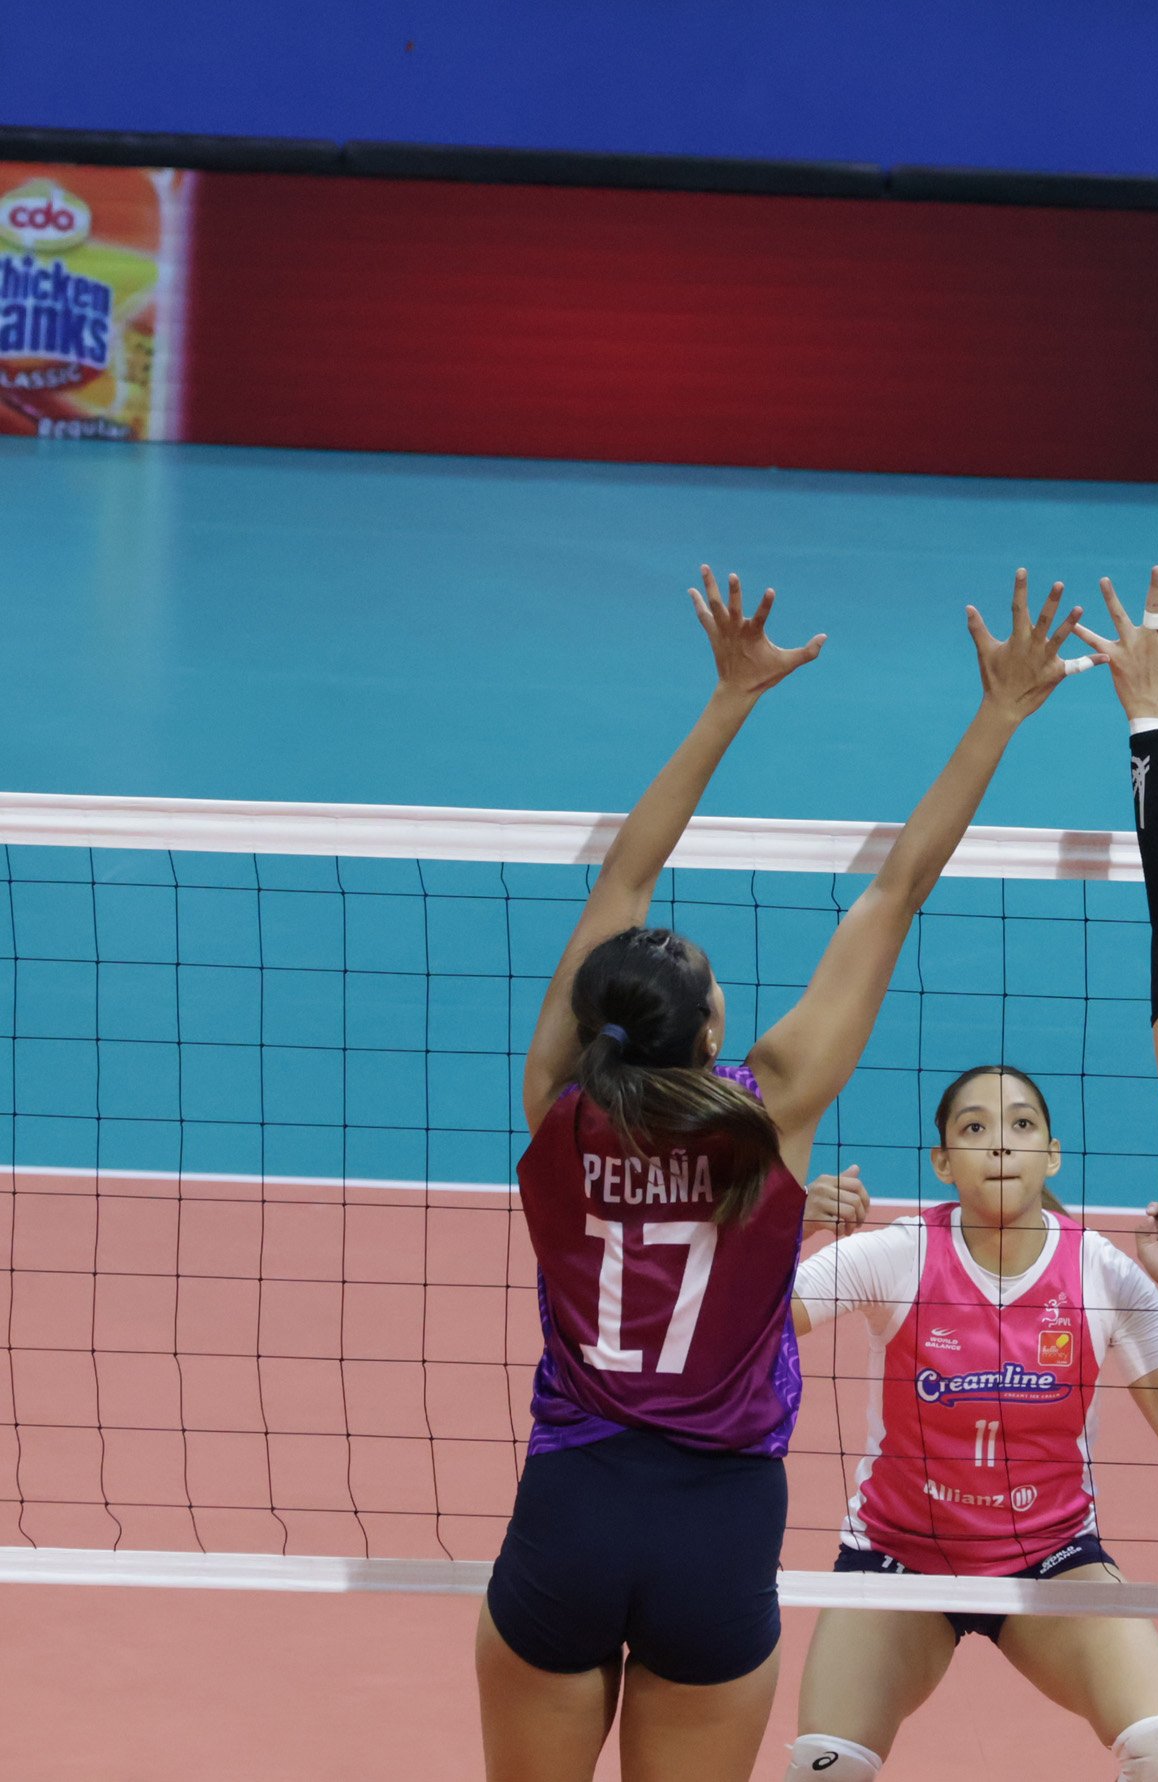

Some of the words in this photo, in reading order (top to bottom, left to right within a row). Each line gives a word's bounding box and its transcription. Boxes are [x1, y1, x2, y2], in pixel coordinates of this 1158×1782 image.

[9, 200, 75, 232] cdo
[0, 256, 110, 316] hicken
[0, 303, 108, 364] anks
[0, 363, 83, 388] LASSIC
[583, 1149, 713, 1205] PECAÑA
[580, 1213, 718, 1374] 17
[925, 1341, 961, 1351] BALANCE
[930, 1337, 958, 1345] WORLD
[917, 1365, 1053, 1402] Creamline
[975, 1419, 999, 1468] 11
[923, 1479, 1004, 1508] Allianz
